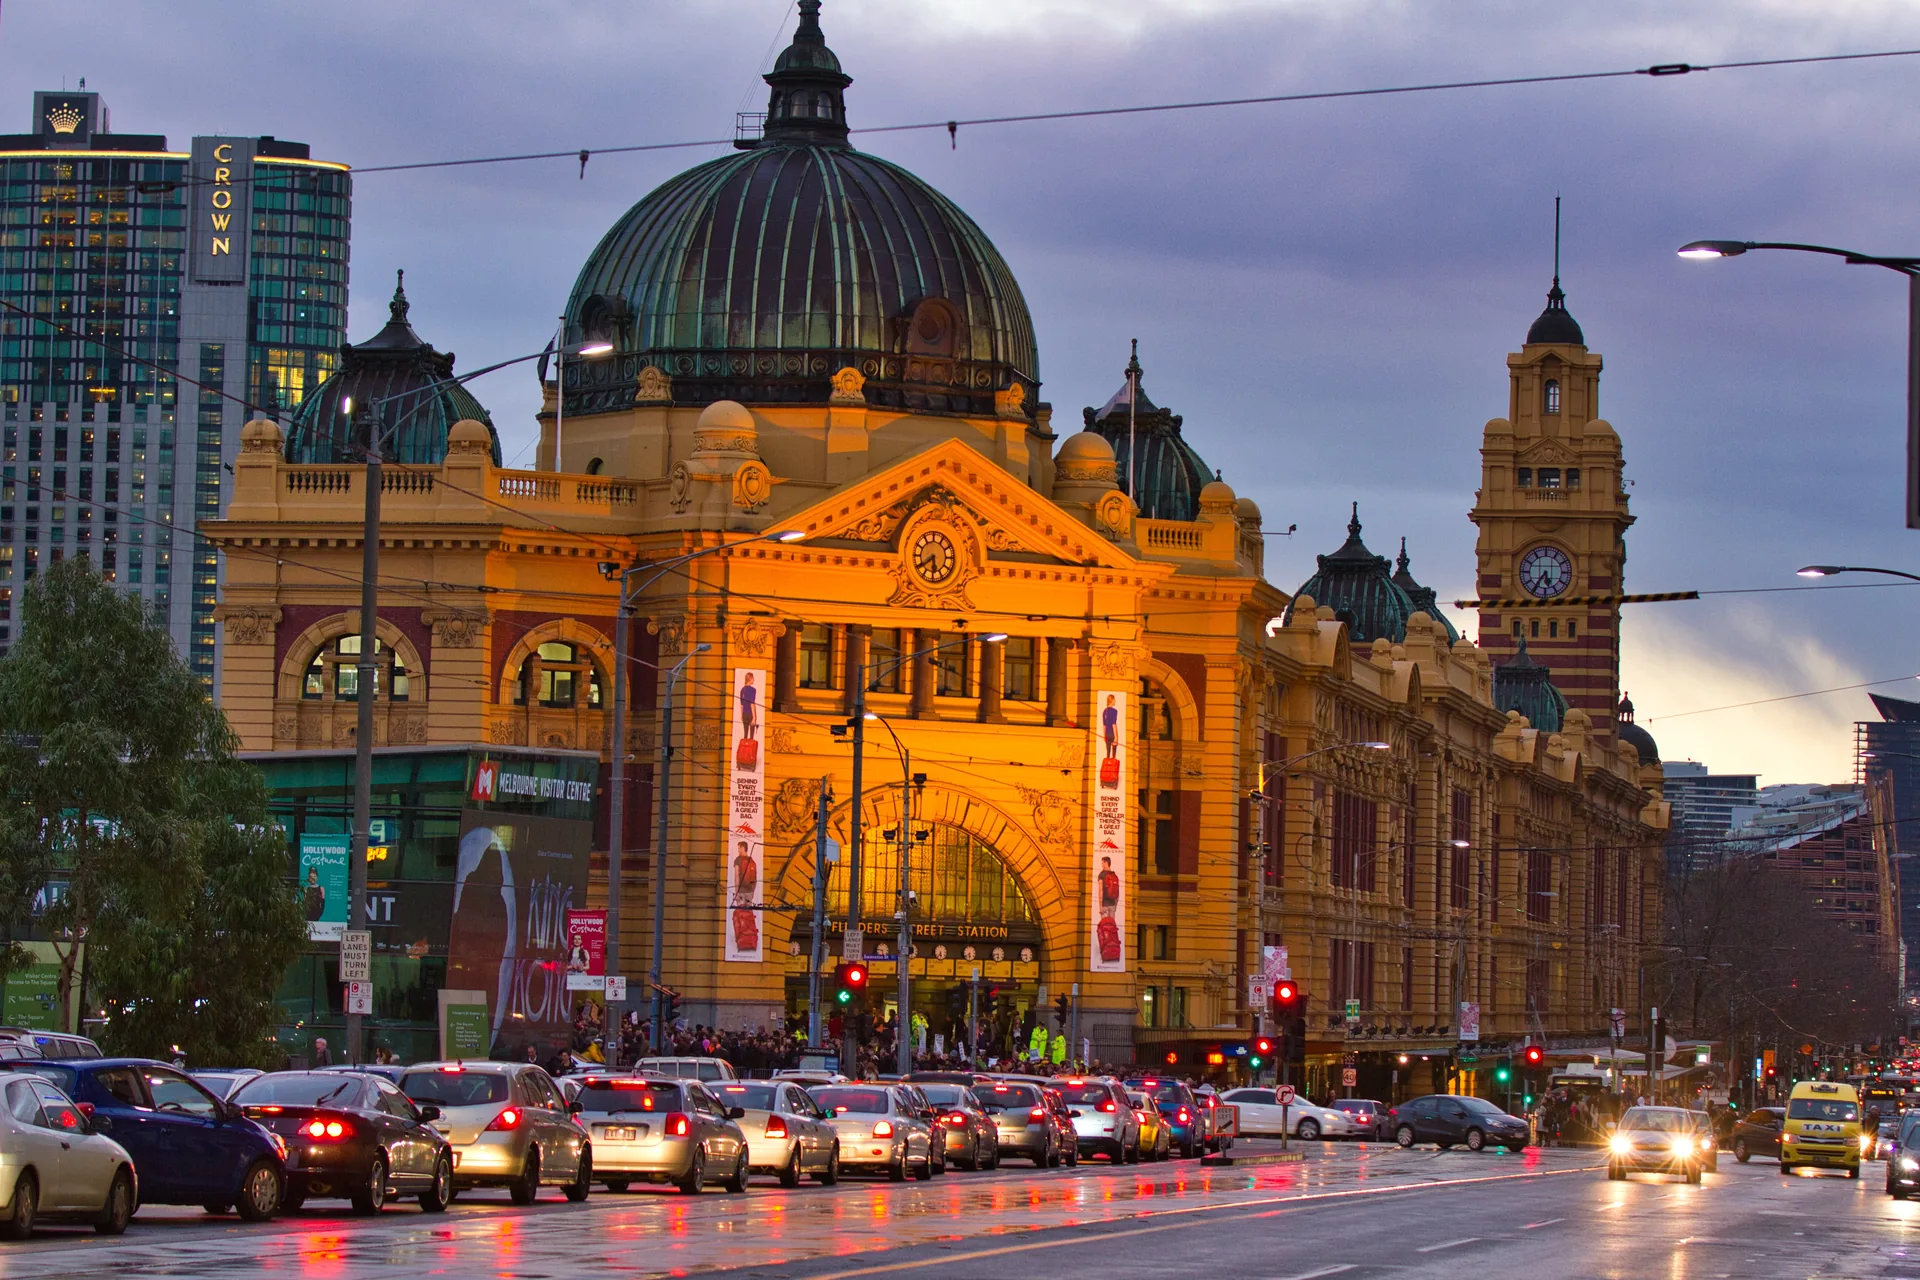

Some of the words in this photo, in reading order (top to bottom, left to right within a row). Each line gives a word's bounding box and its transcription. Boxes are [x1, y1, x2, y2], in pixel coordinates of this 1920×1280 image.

[211, 143, 233, 256] CROWN
[499, 773, 538, 796] MELBOURNE
[540, 777, 565, 799] VISITOR
[566, 781, 591, 802] CENTRE
[303, 846, 346, 855] HOLLYWOOD
[301, 854, 347, 866] Costume
[570, 925, 604, 934] Costume
[831, 921, 888, 934] FLIDERS
[958, 926, 1008, 938] STATION
[1804, 1124, 1841, 1132] TAXI
